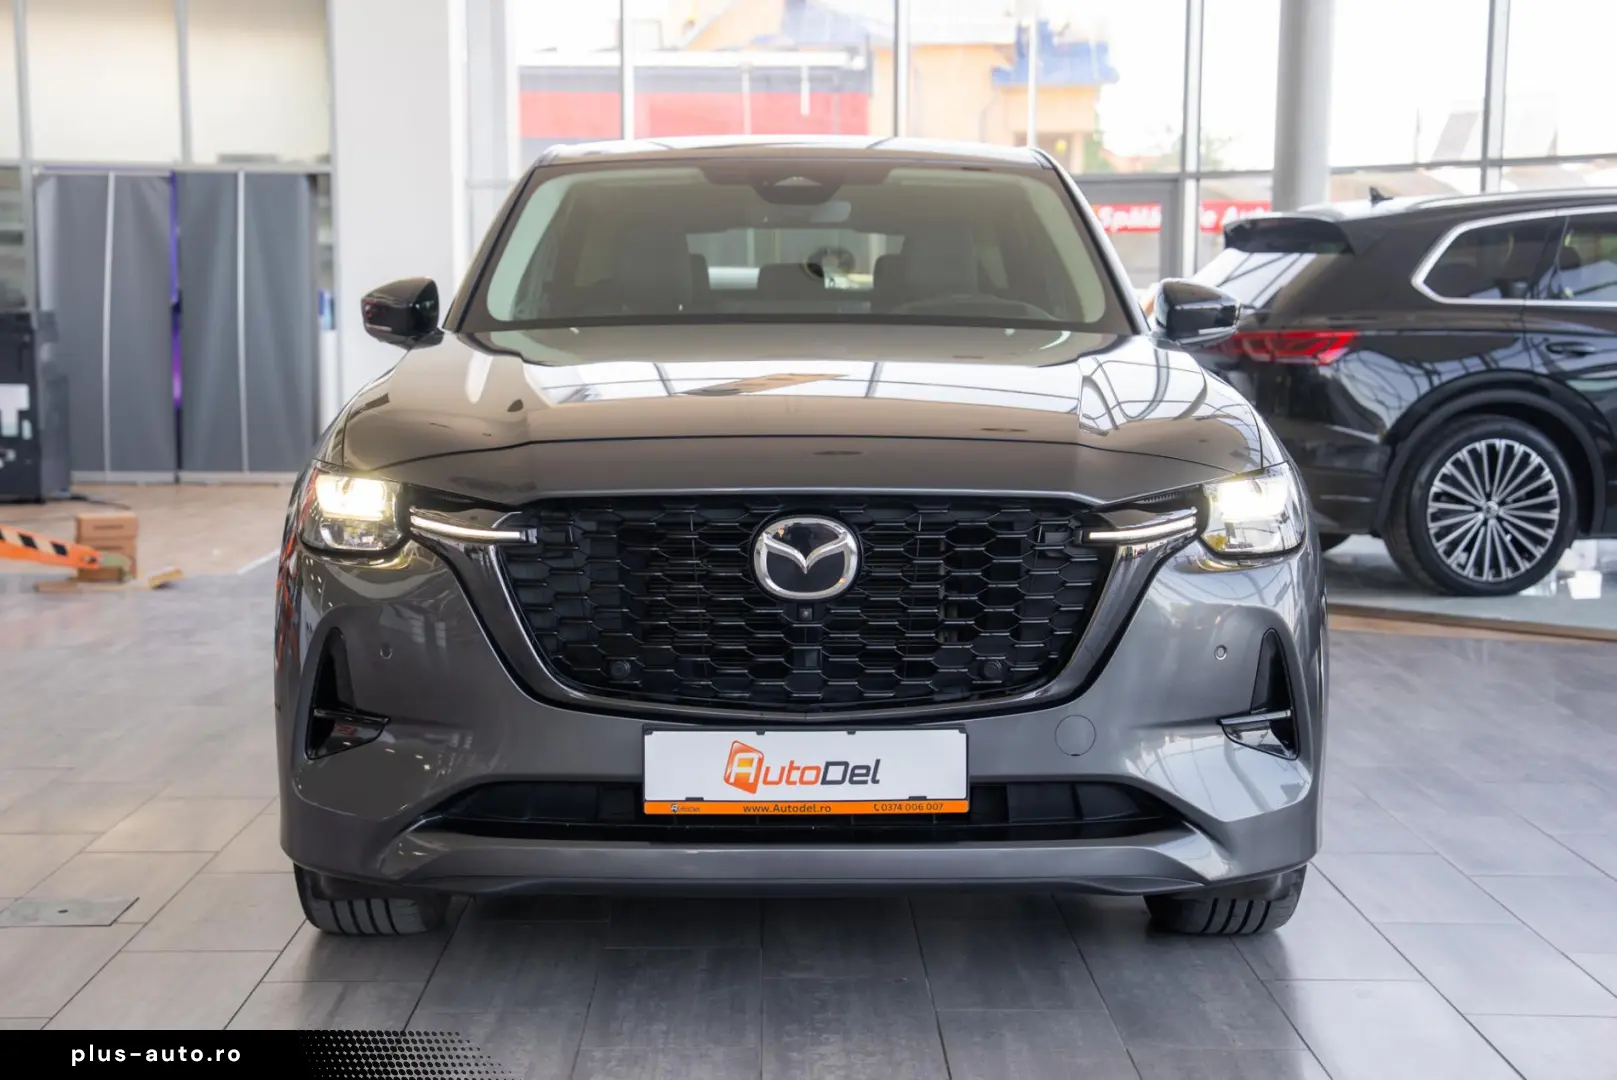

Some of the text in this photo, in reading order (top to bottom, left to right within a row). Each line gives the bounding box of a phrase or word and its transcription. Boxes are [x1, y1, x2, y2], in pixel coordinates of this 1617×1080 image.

[726, 746, 881, 789] AutoDel
[743, 803, 832, 813] www.Autodel.ro
[881, 803, 944, 811] 0374 006 007
